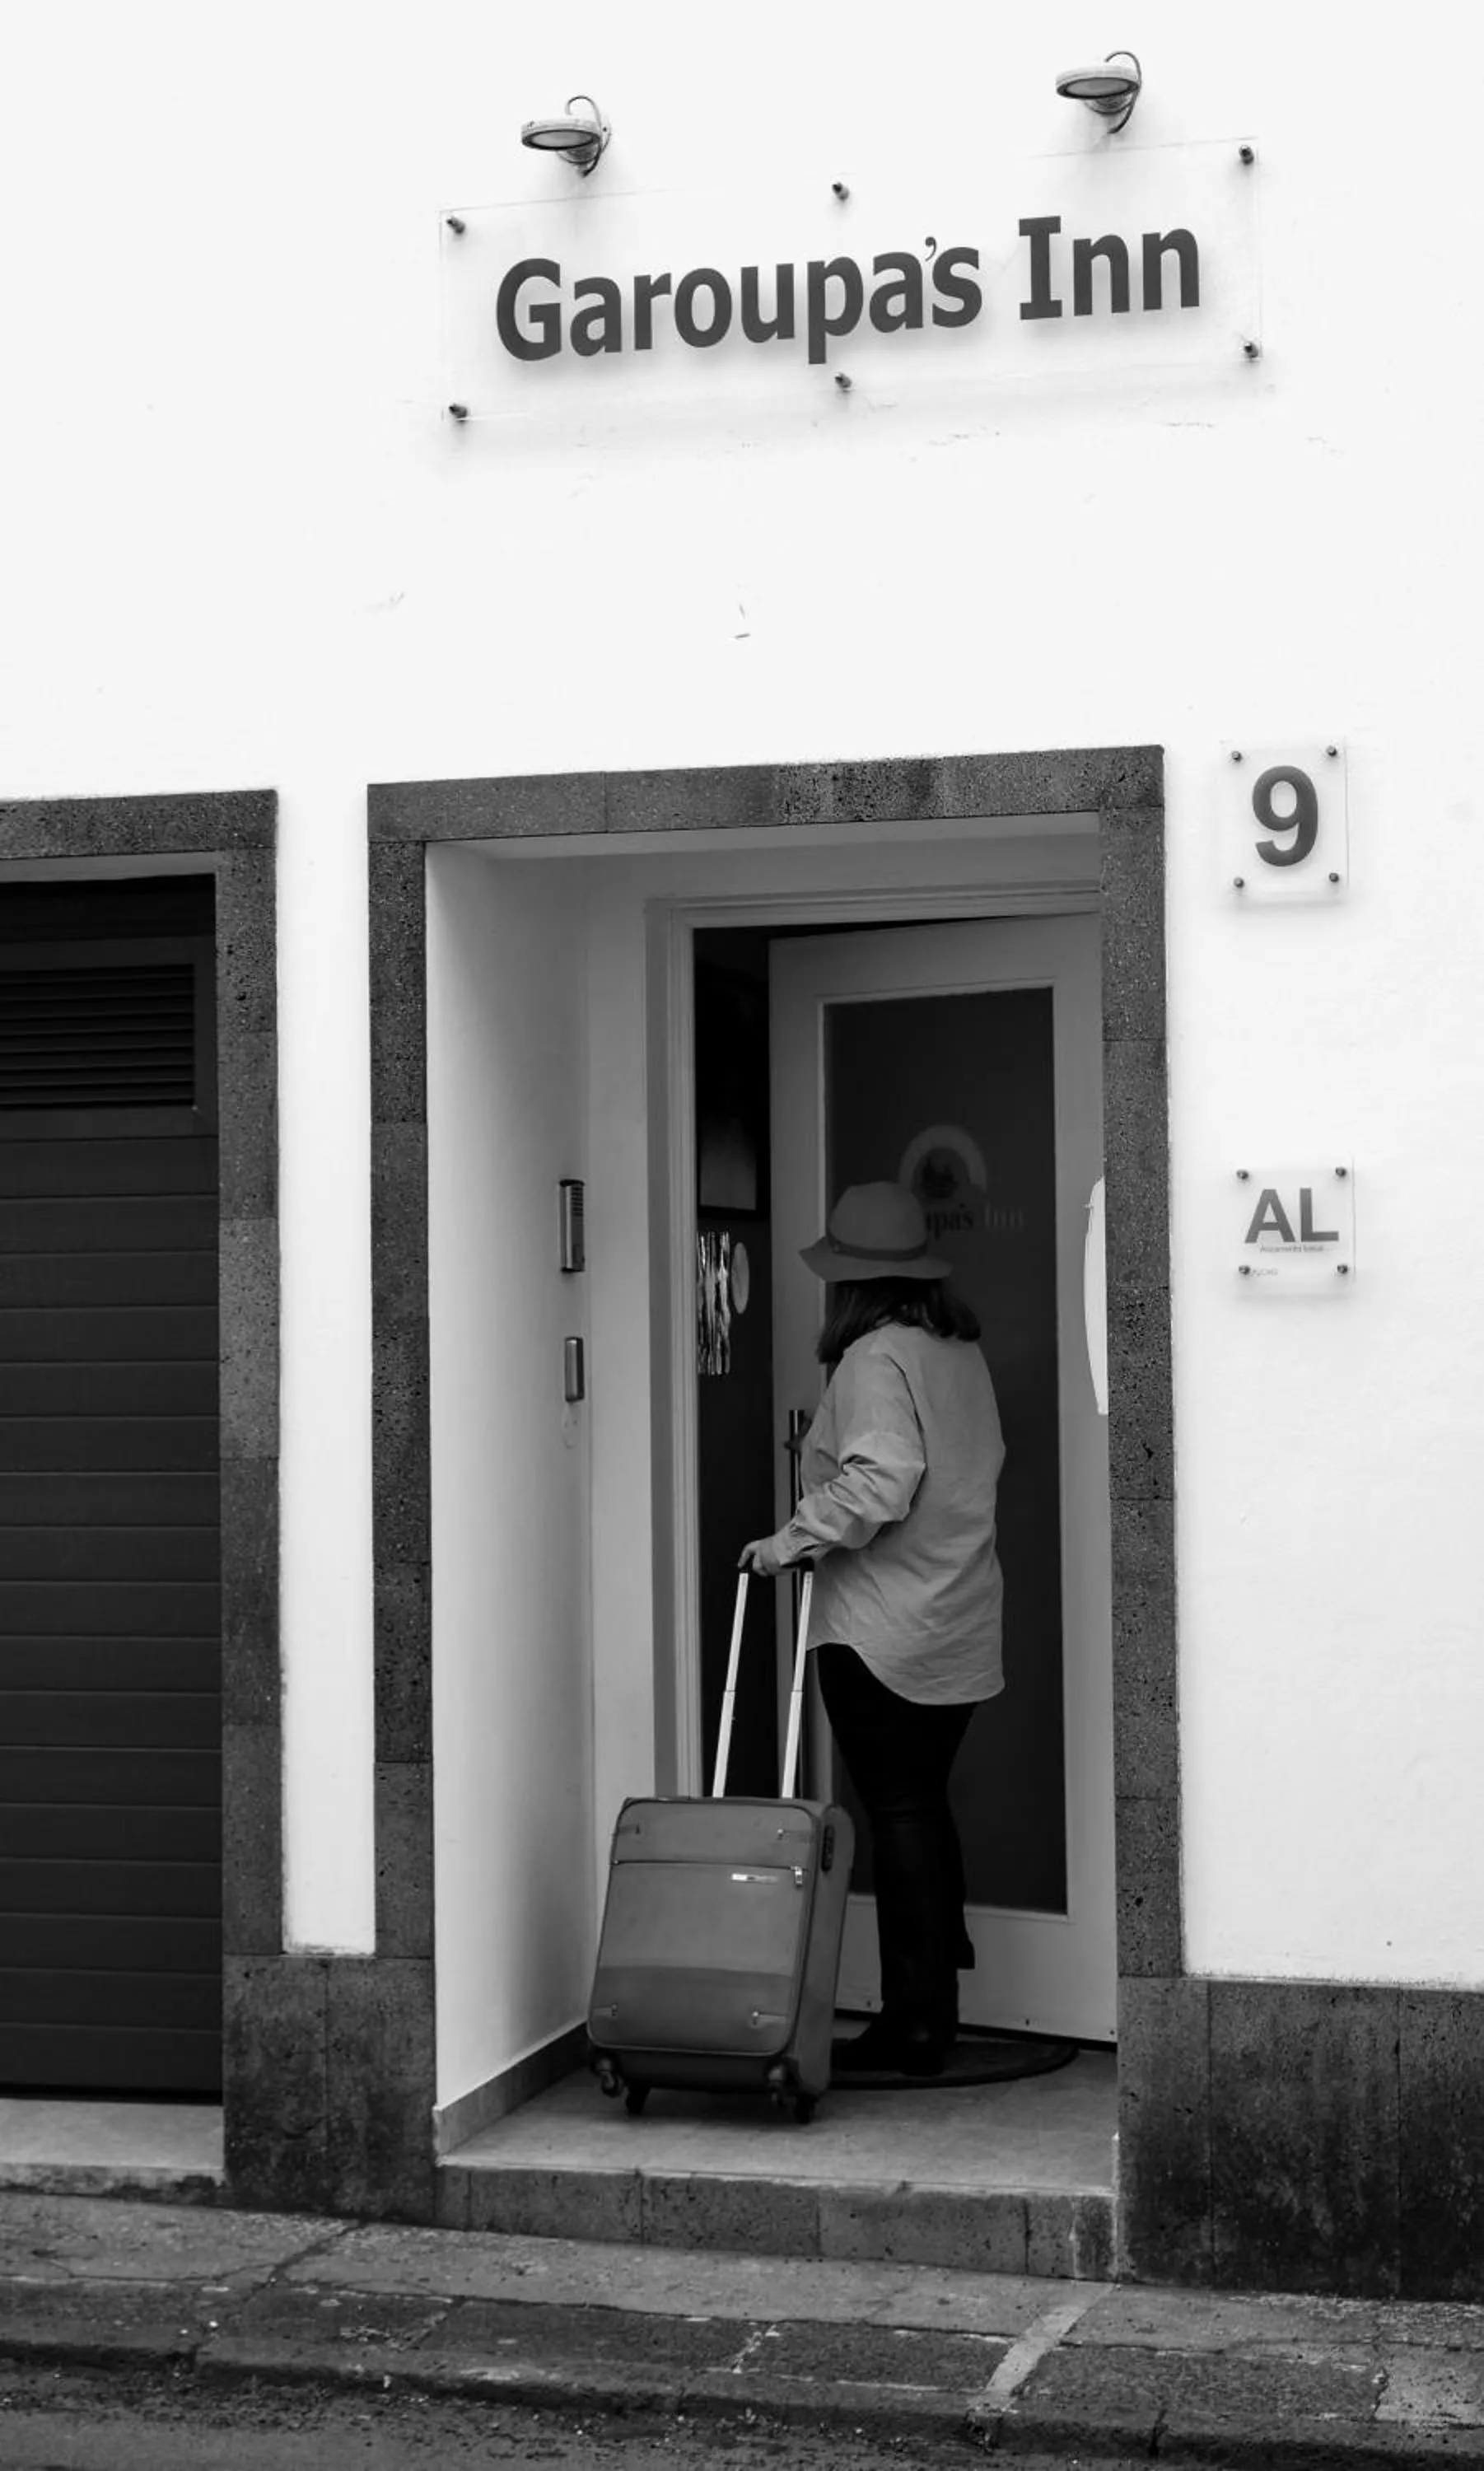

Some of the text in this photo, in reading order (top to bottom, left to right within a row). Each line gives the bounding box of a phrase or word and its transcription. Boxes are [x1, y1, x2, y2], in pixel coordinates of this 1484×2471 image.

[496, 215, 1200, 365] Garoupa's Inn
[1252, 765, 1318, 867] 9
[1244, 1188, 1339, 1244] AL
